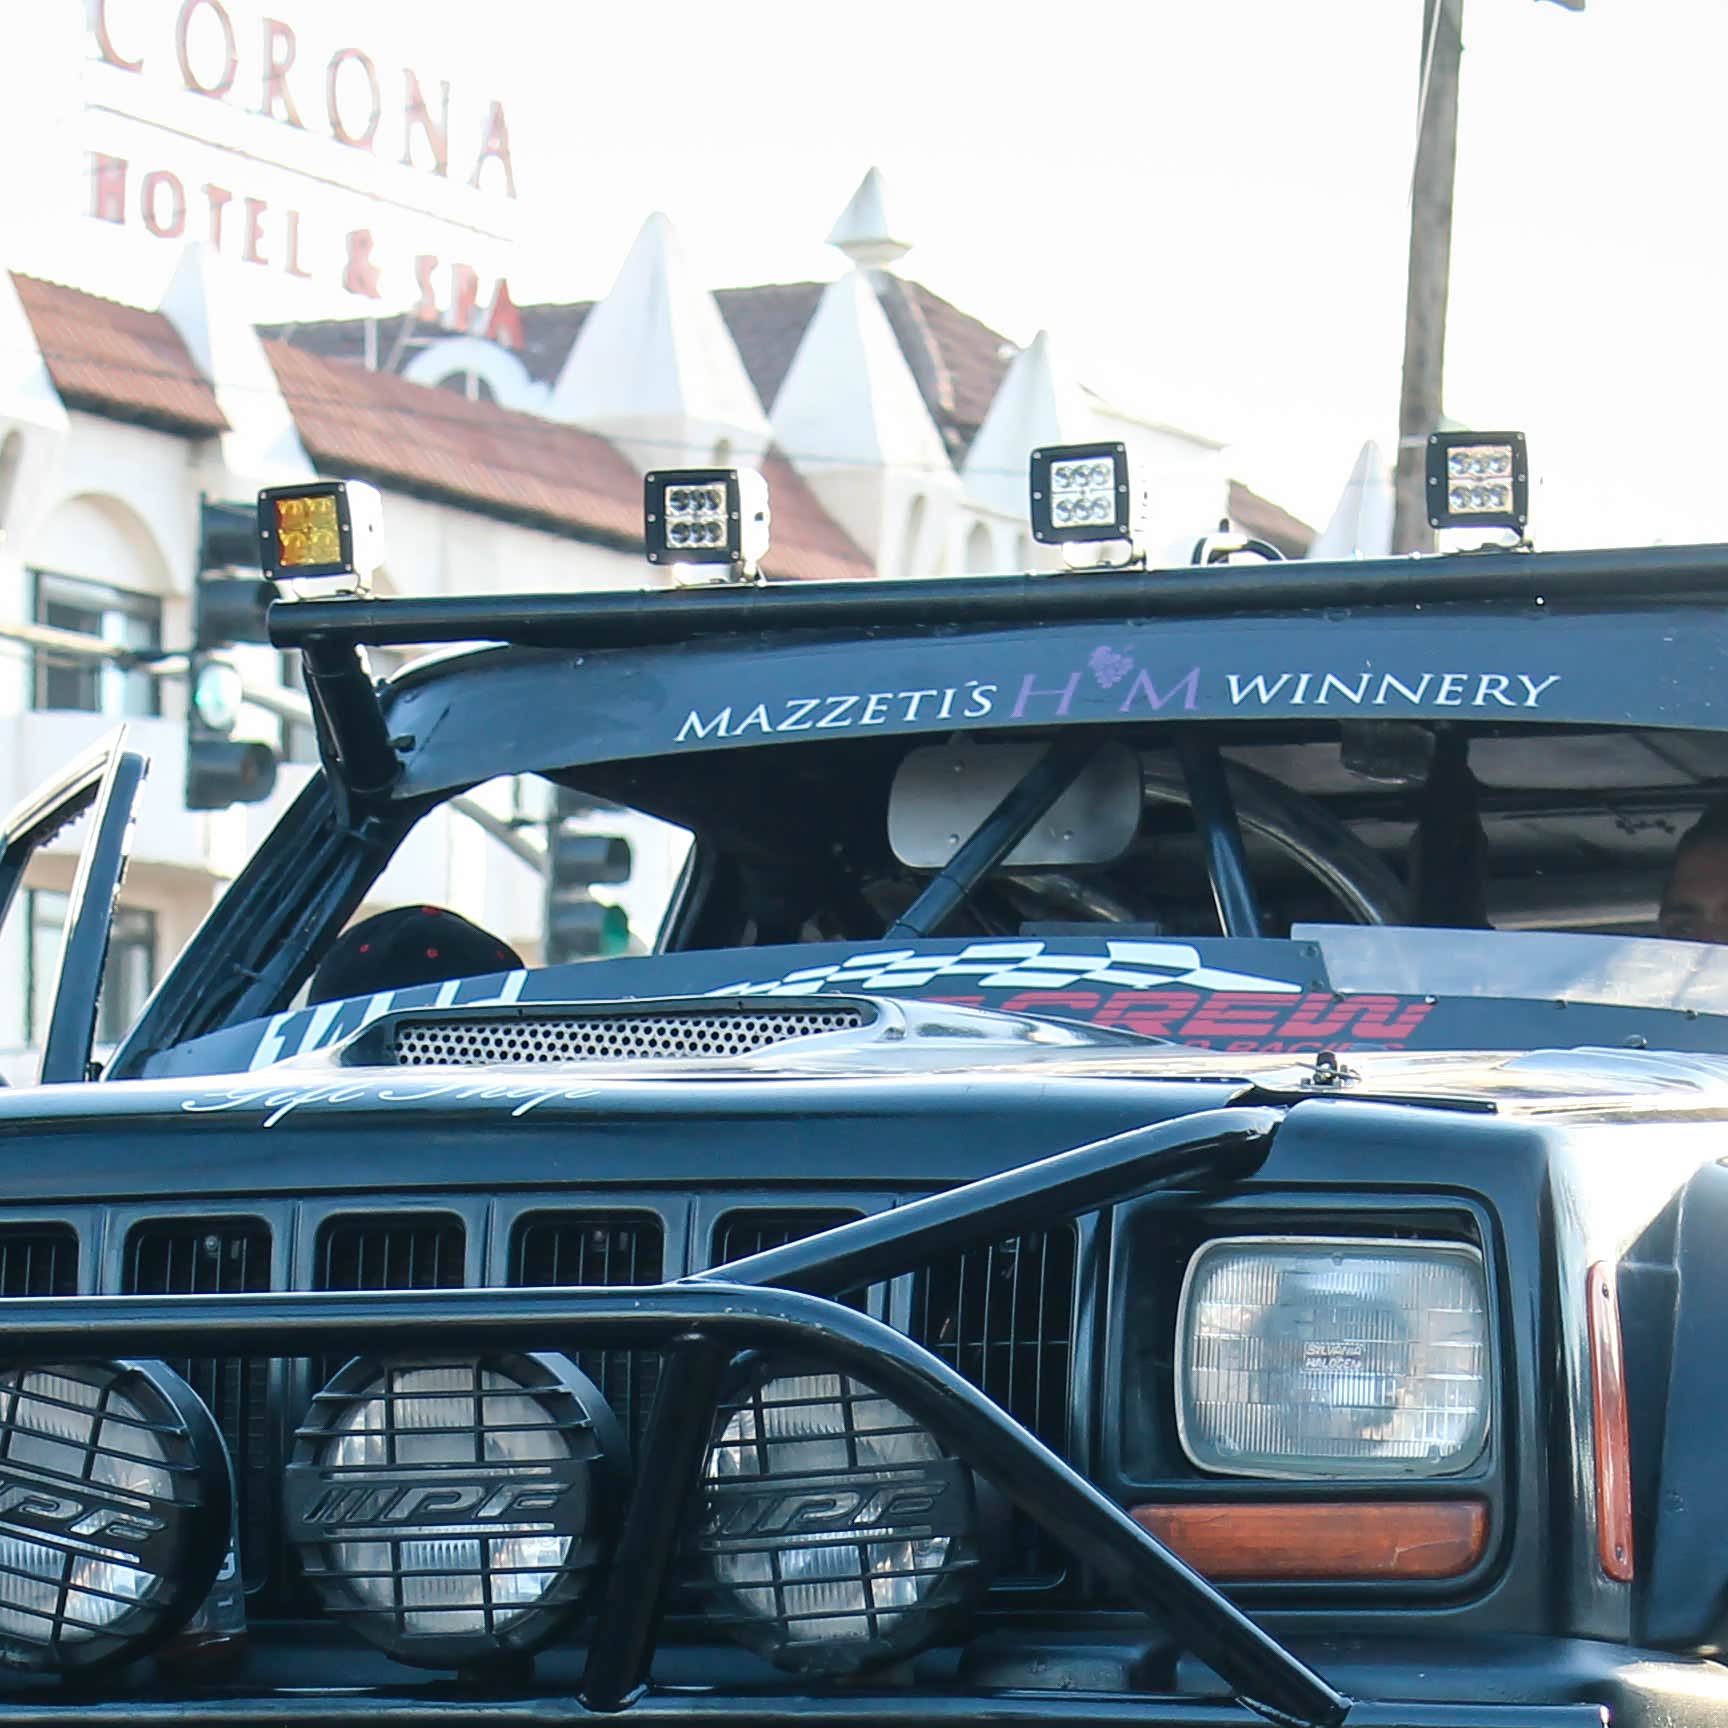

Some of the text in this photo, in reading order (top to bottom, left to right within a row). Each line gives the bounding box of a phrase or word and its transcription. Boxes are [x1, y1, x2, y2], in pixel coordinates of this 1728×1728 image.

[83, 0, 518, 199] CORONA
[83, 150, 525, 350] HOTEL & SPA
[1224, 671, 1562, 710] WINNERY
